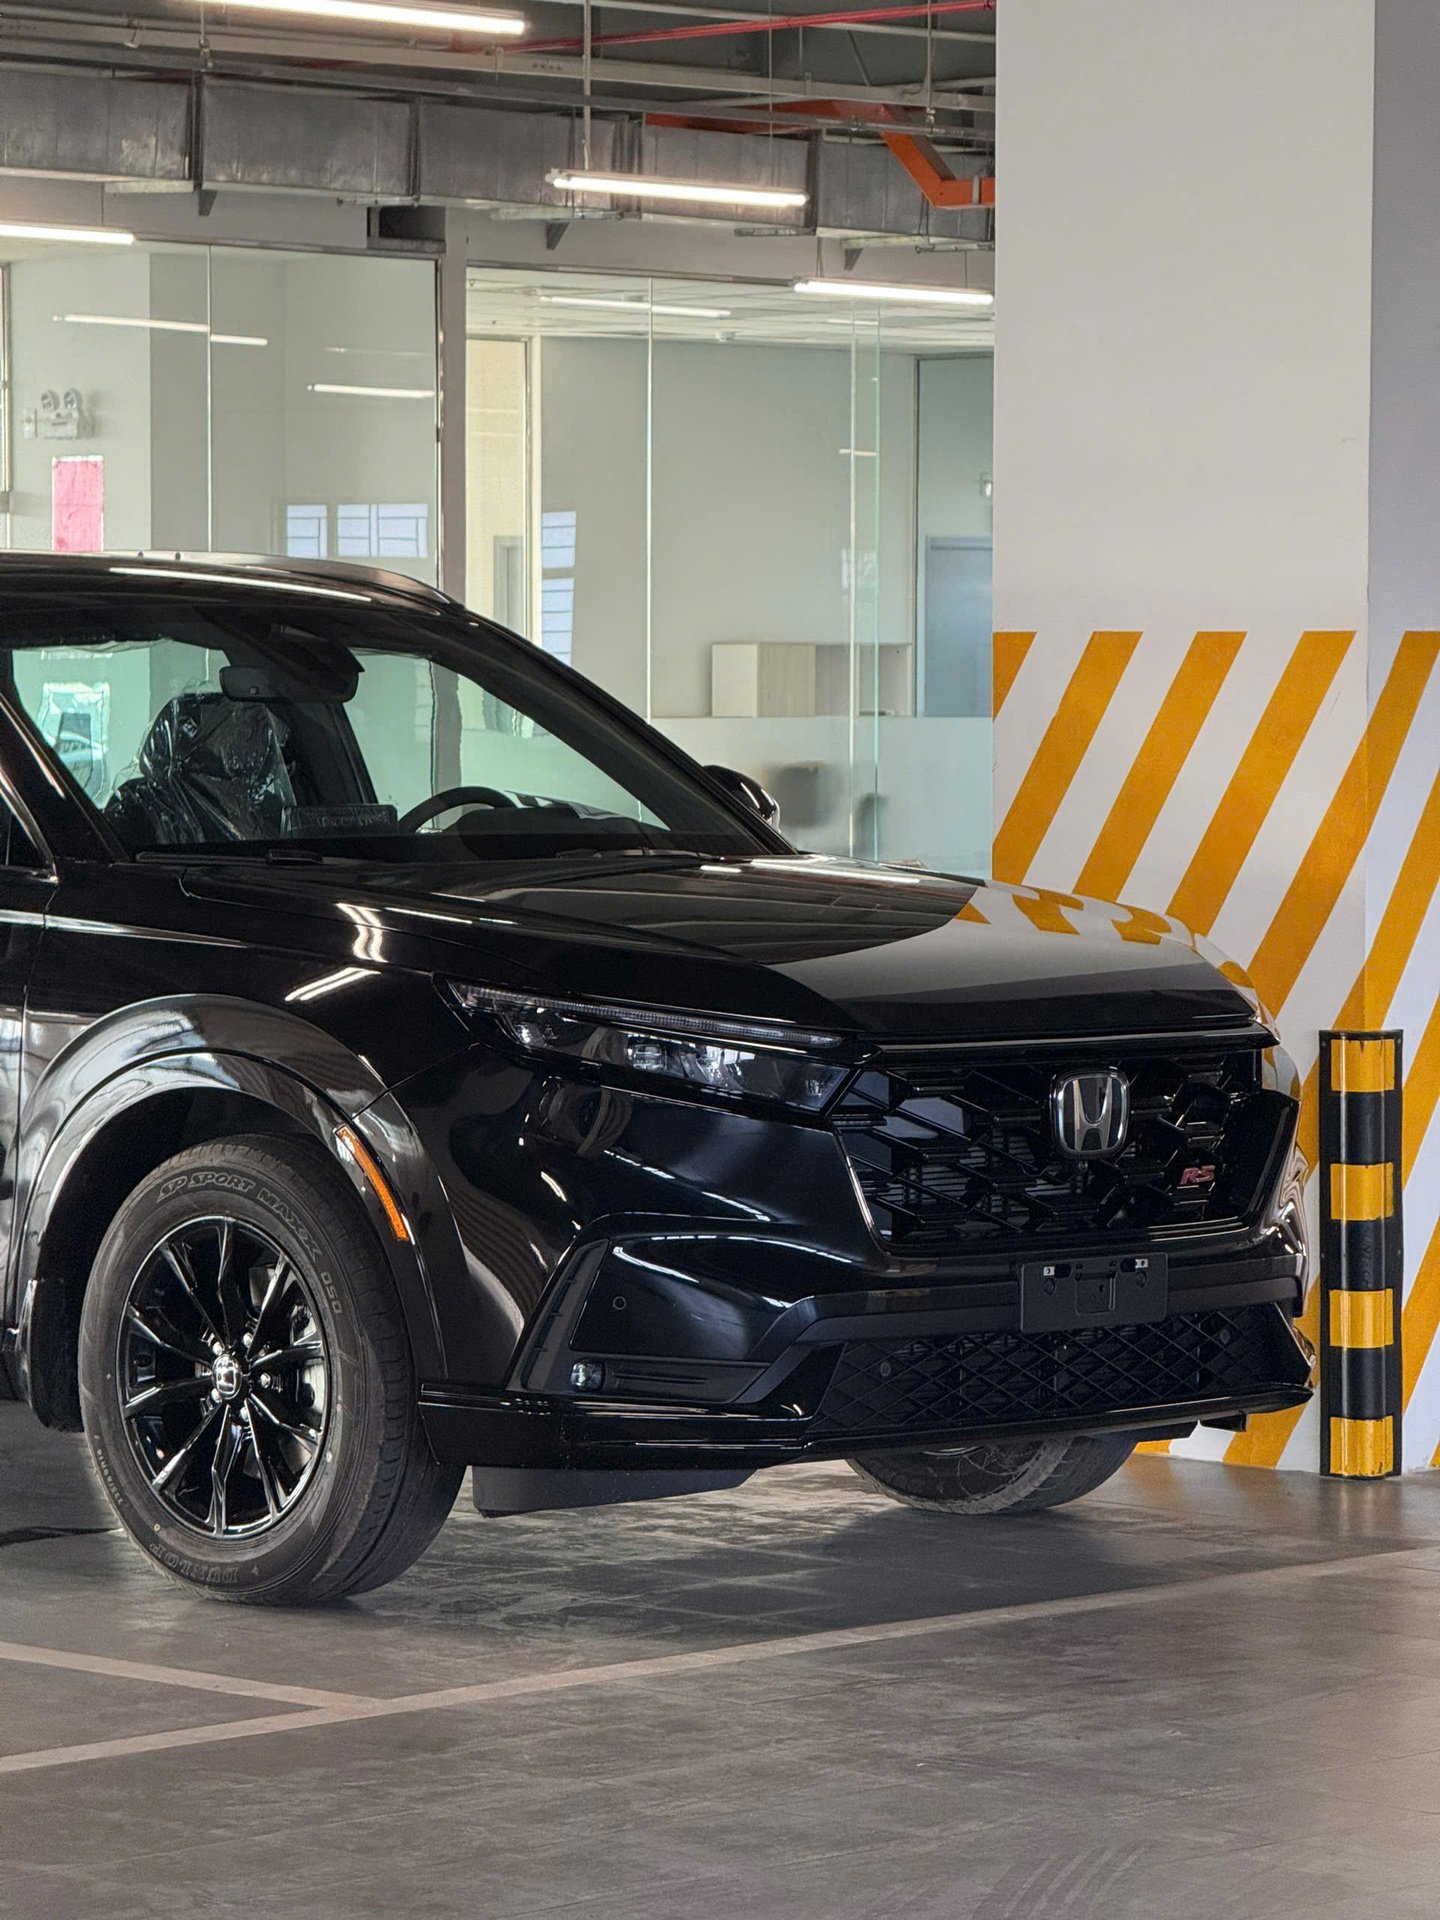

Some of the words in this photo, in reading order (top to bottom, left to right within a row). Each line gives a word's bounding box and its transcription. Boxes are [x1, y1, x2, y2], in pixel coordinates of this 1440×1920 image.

[1180, 1164, 1216, 1185] RS
[157, 1175, 188, 1202] SP
[187, 1172, 256, 1193] SPORT
[256, 1188, 323, 1264] MAXX
[149, 1542, 239, 1583] DUNLOP
